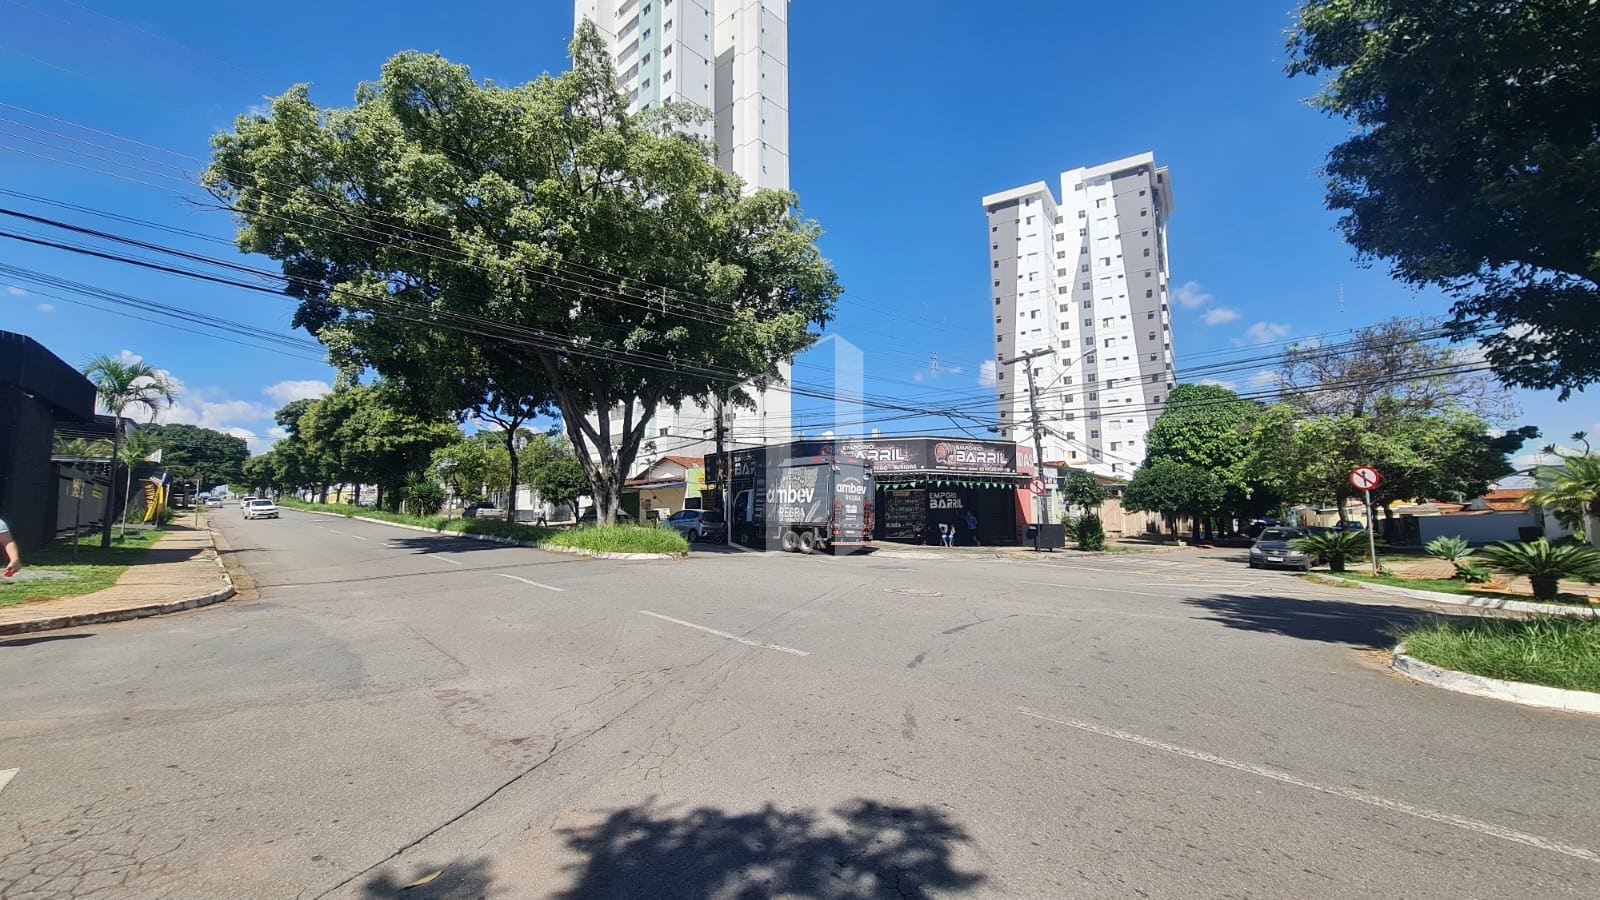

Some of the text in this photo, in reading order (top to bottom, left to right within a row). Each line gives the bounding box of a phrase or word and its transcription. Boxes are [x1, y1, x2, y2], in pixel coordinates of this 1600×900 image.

[956, 451, 1008, 464] BARRIL
[766, 484, 815, 504] ambev
[836, 482, 867, 495] ambev
[929, 498, 964, 509] BARRIL
[779, 507, 806, 518] REGRA
